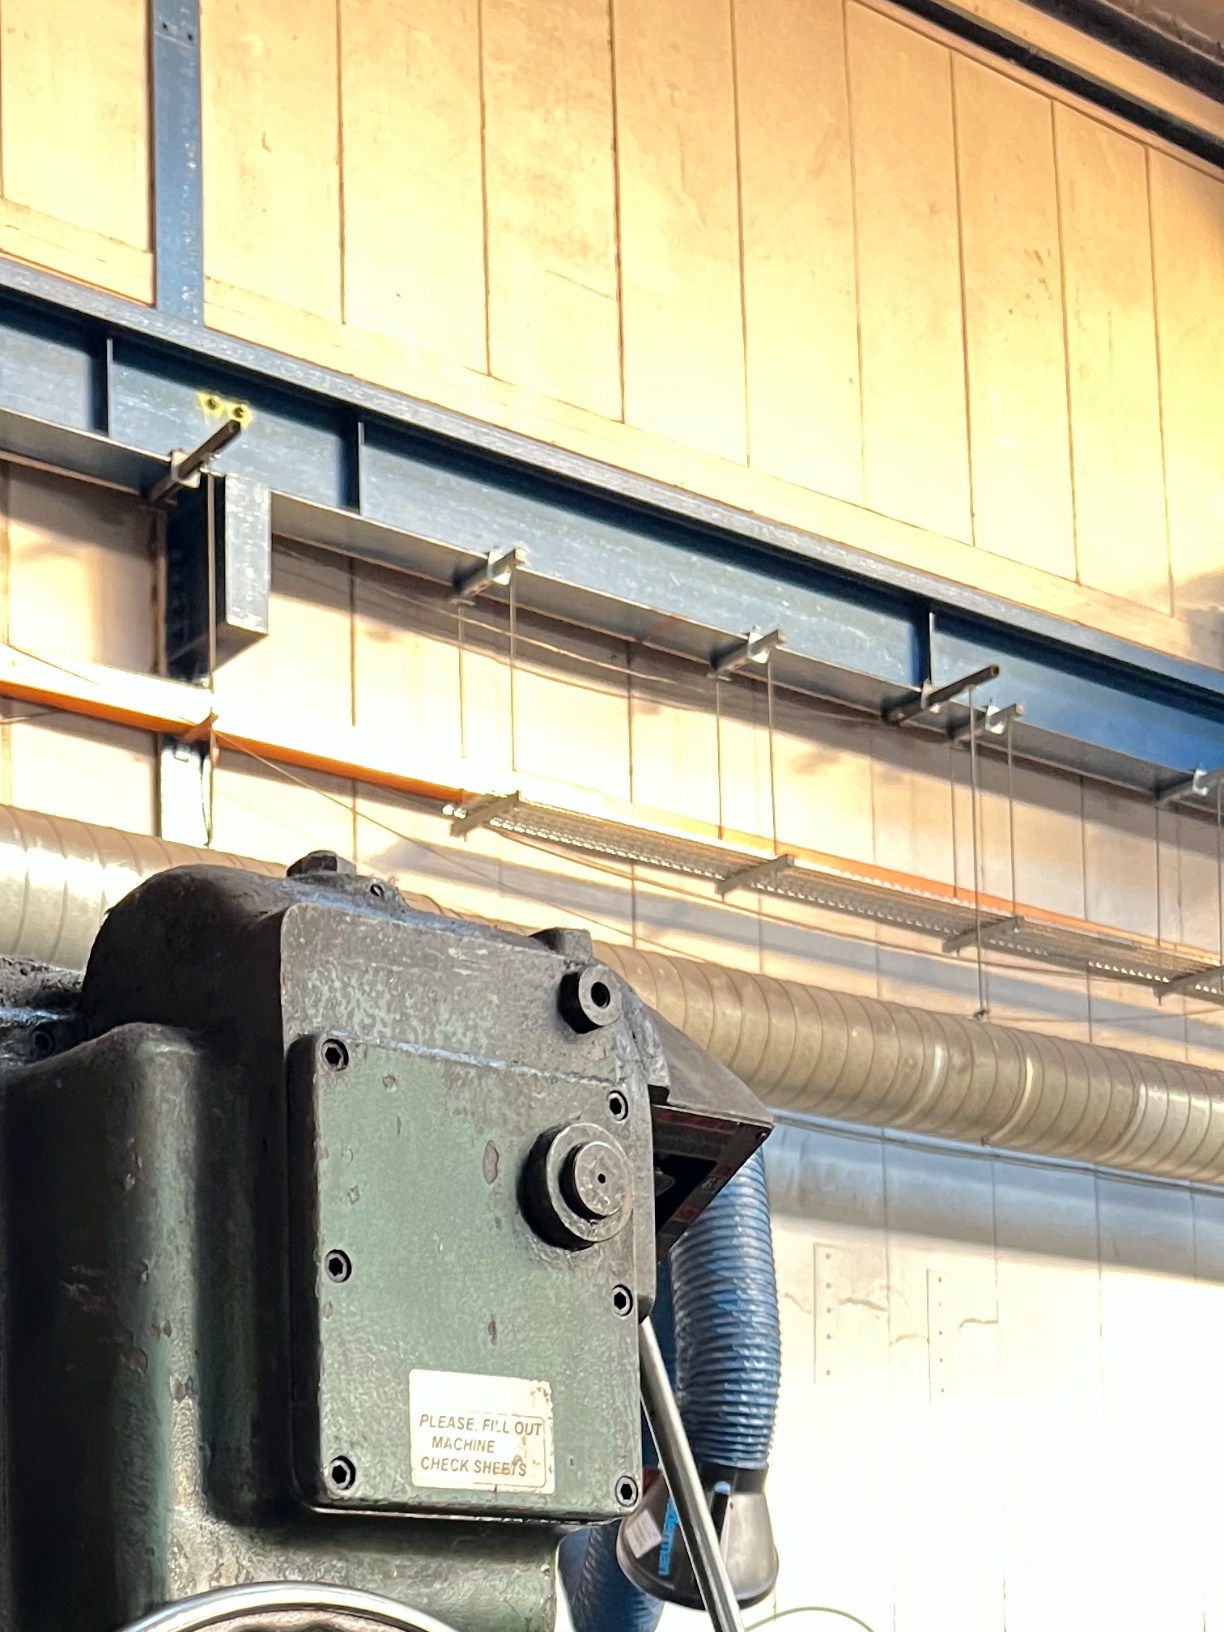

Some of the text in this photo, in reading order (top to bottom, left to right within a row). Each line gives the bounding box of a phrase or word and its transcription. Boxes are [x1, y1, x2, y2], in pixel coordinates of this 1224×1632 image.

[514, 1421, 543, 1436] OUT
[431, 1436, 495, 1453] MACHINE
[421, 1456, 527, 1477] CHECK SHEETS
